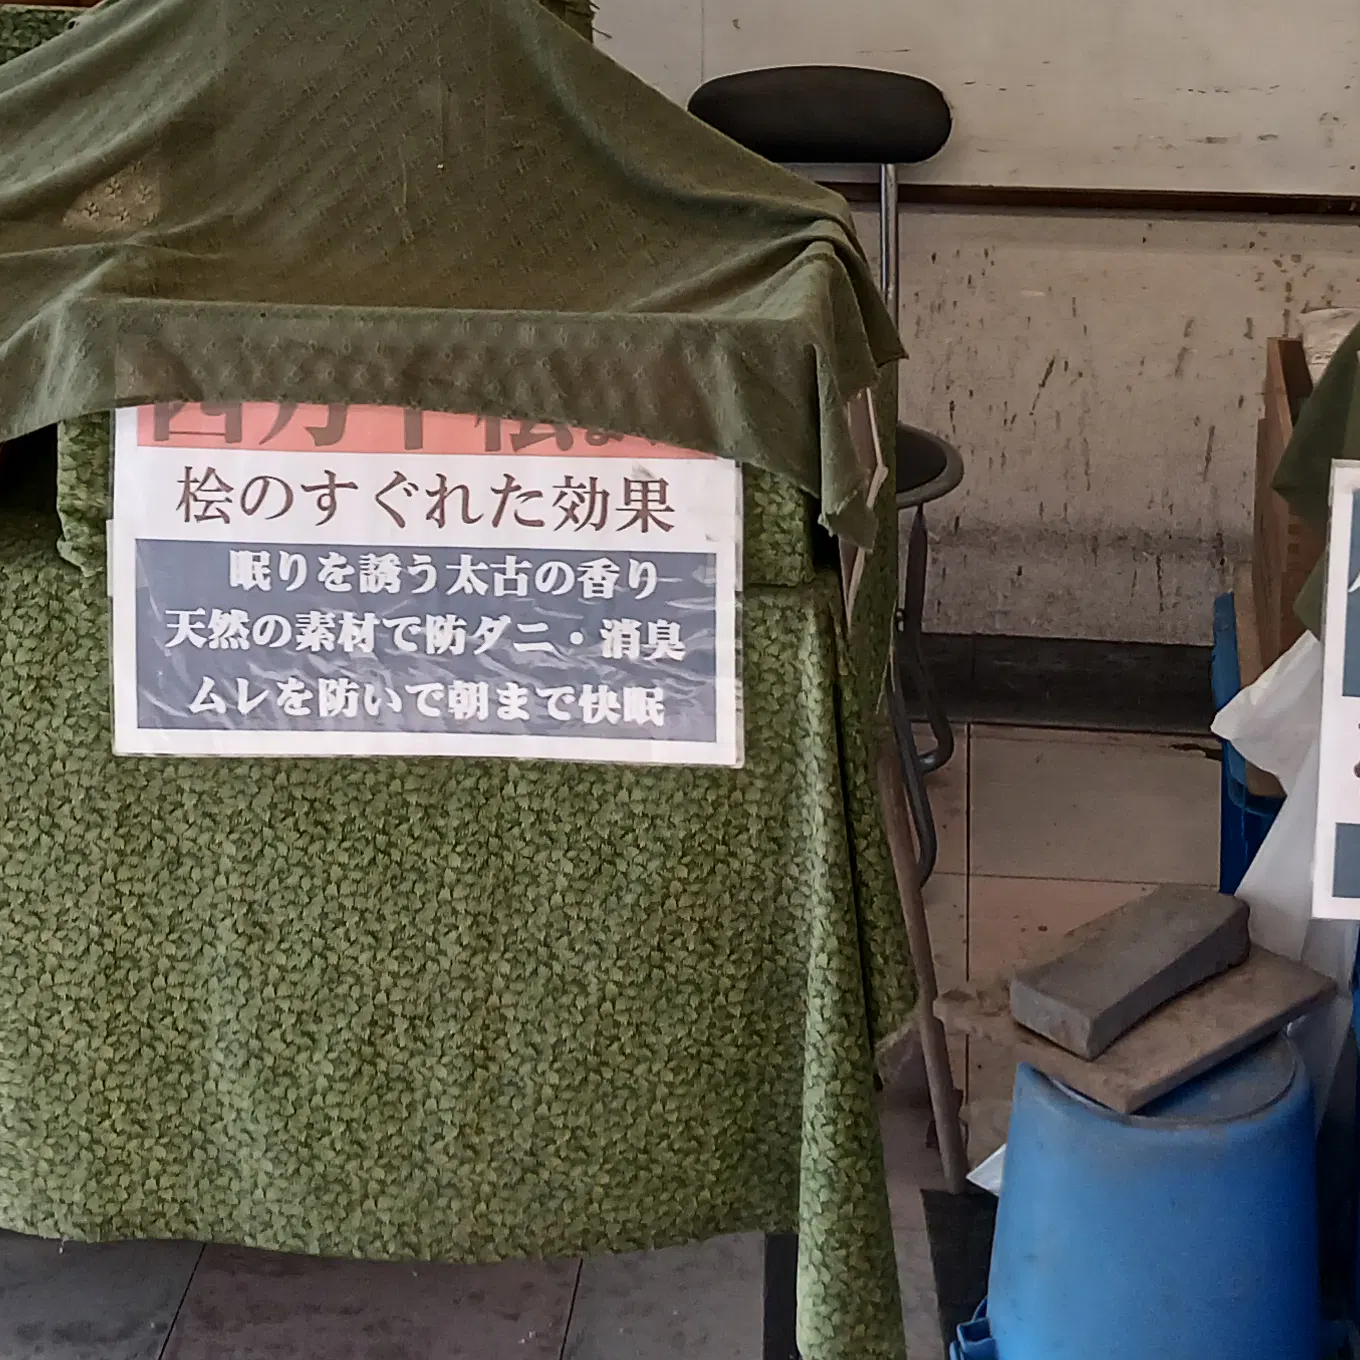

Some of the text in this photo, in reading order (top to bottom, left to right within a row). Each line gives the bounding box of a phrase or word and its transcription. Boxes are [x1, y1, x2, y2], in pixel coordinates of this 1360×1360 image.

[175, 464, 677, 534] 桧のすぐれた効果
[228, 549, 659, 602] 眠りを誘う太古の香り
[163, 608, 686, 664] 天然の素材で防ダニ・消臭
[186, 675, 666, 728] ムレを防いで朝まで快眠
